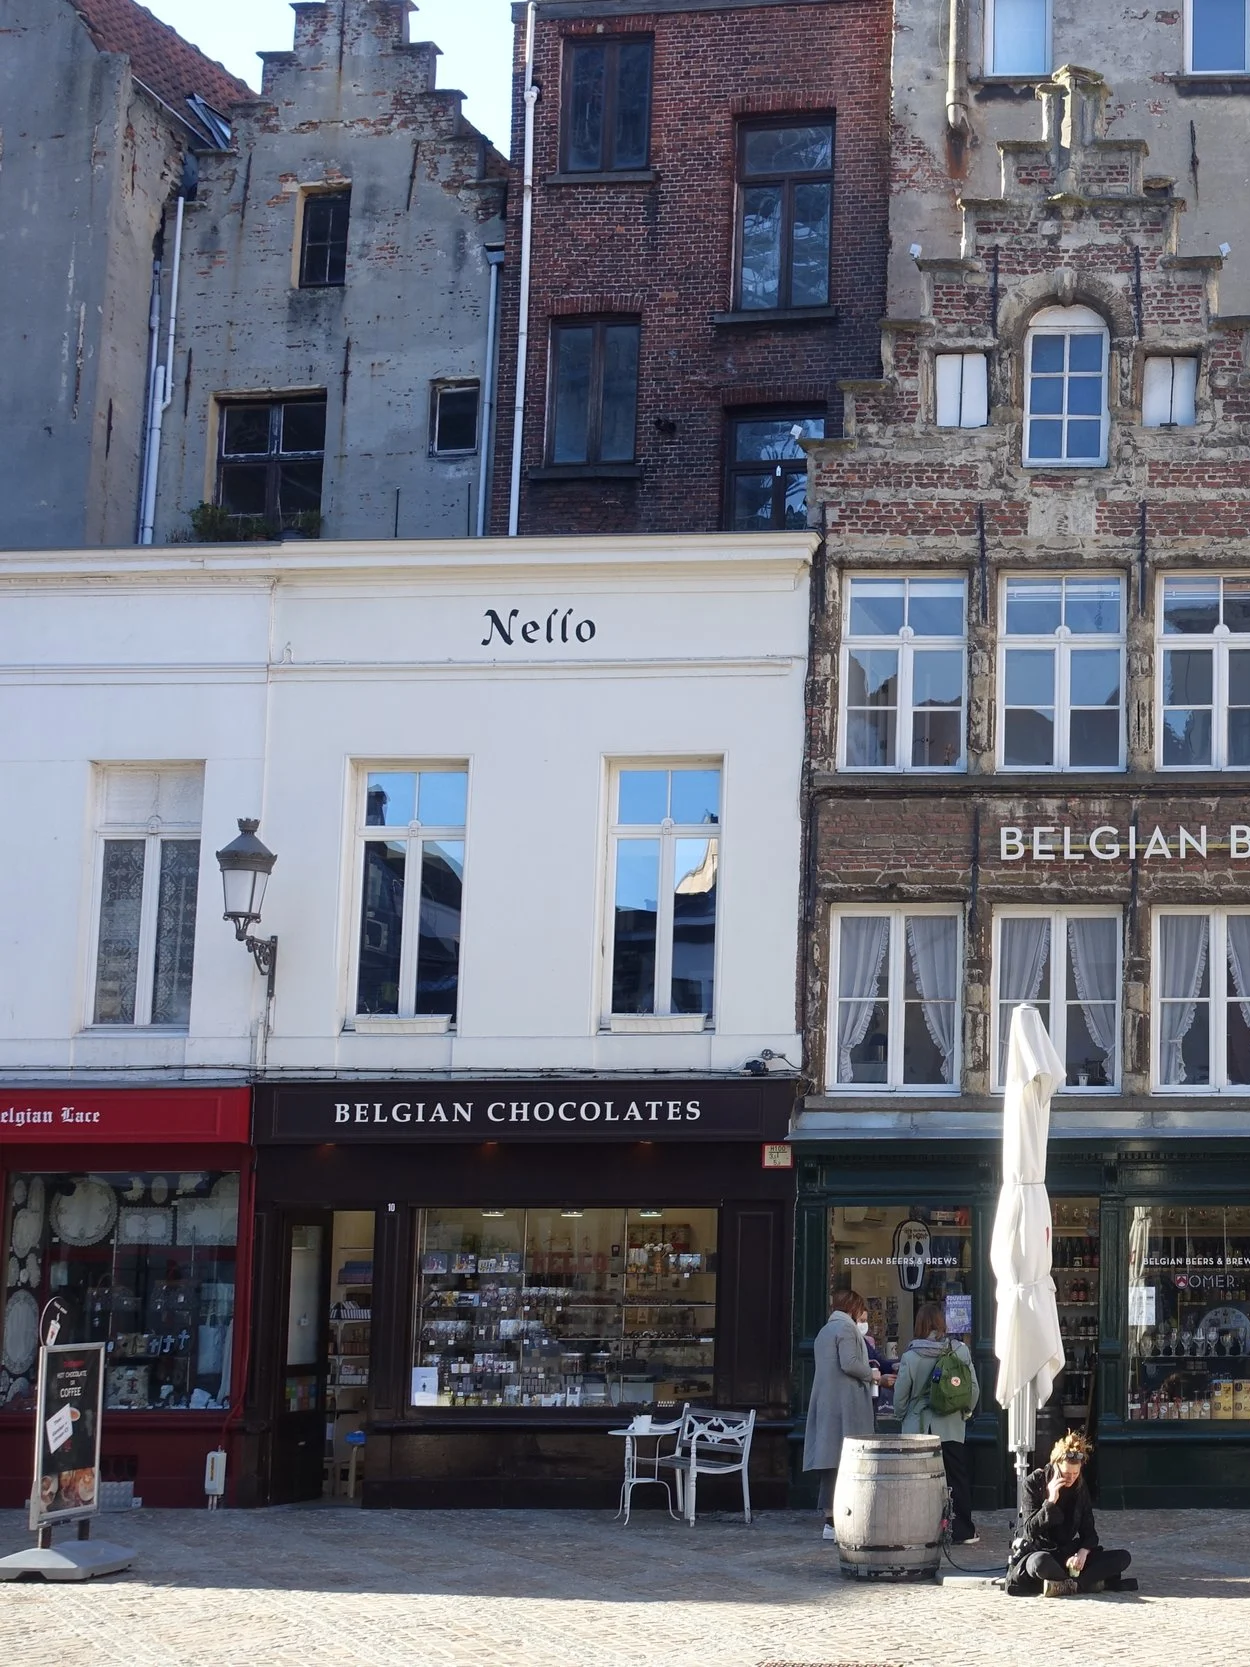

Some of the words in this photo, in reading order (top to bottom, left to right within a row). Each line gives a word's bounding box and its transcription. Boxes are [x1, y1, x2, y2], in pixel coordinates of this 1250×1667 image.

[481, 608, 596, 646] Nello
[1000, 826, 1207, 860] BELGIAN
[0, 1107, 53, 1127] elgian
[61, 1107, 100, 1123] Lace
[335, 1103, 474, 1123] BELGIAN
[487, 1100, 701, 1122] CHOCOLATES
[388, 1203, 396, 1212] 10
[844, 1257, 883, 1265] BELGIAN
[886, 1257, 914, 1265] BEERS
[917, 1257, 924, 1265] &
[927, 1257, 958, 1265] BREWS
[1143, 1257, 1183, 1265] BELGIAN
[1185, 1257, 1214, 1265] BEERS
[1216, 1257, 1223, 1265] &
[60, 1386, 82, 1398] COFFEE
